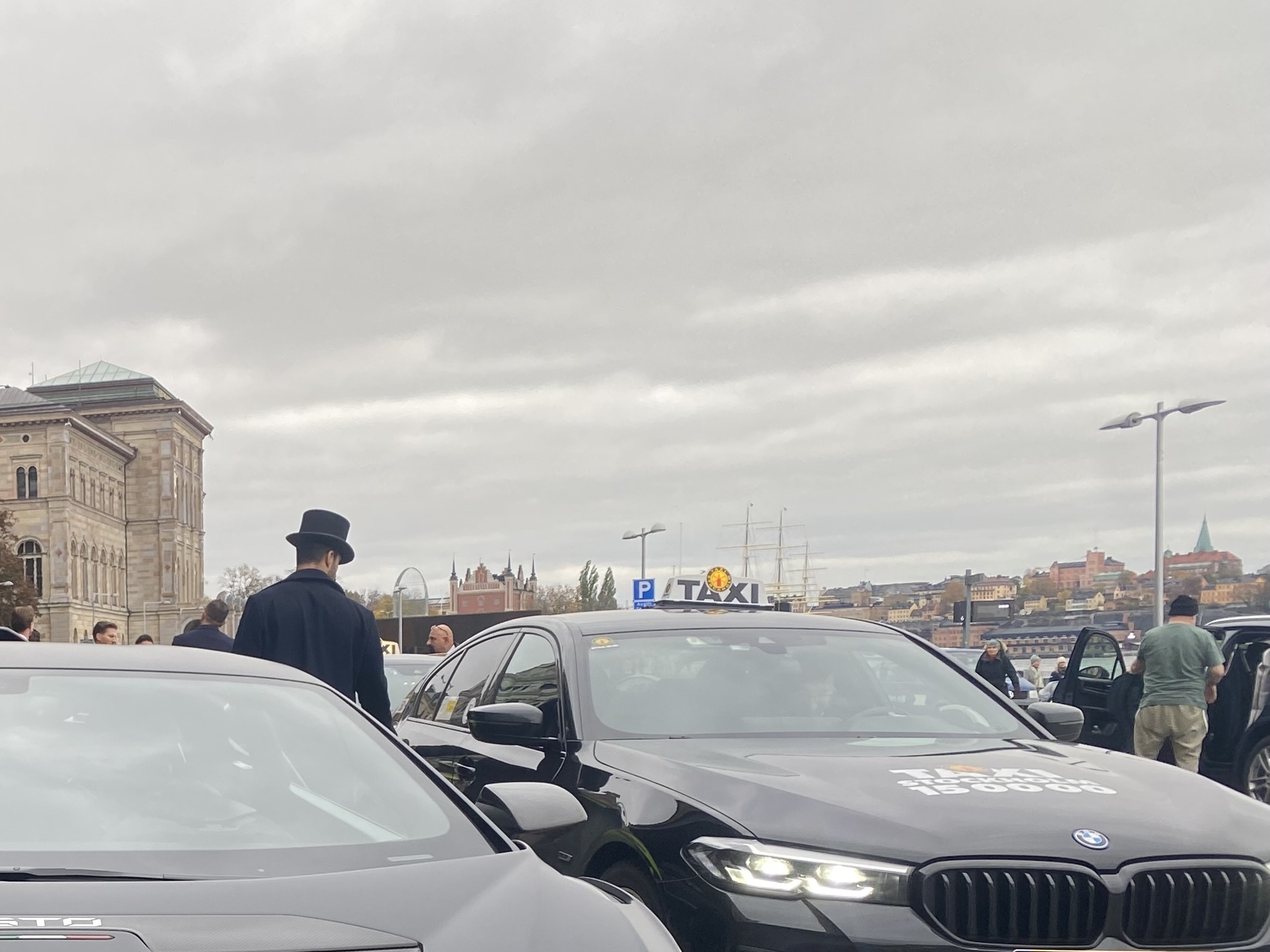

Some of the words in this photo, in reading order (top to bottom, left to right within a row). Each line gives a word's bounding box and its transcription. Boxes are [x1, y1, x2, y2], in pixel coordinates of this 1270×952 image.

[638, 580, 651, 599] P
[677, 579, 759, 604] TAXI
[889, 768, 1064, 779] TAXI
[897, 777, 1102, 787] STOCKHOLM
